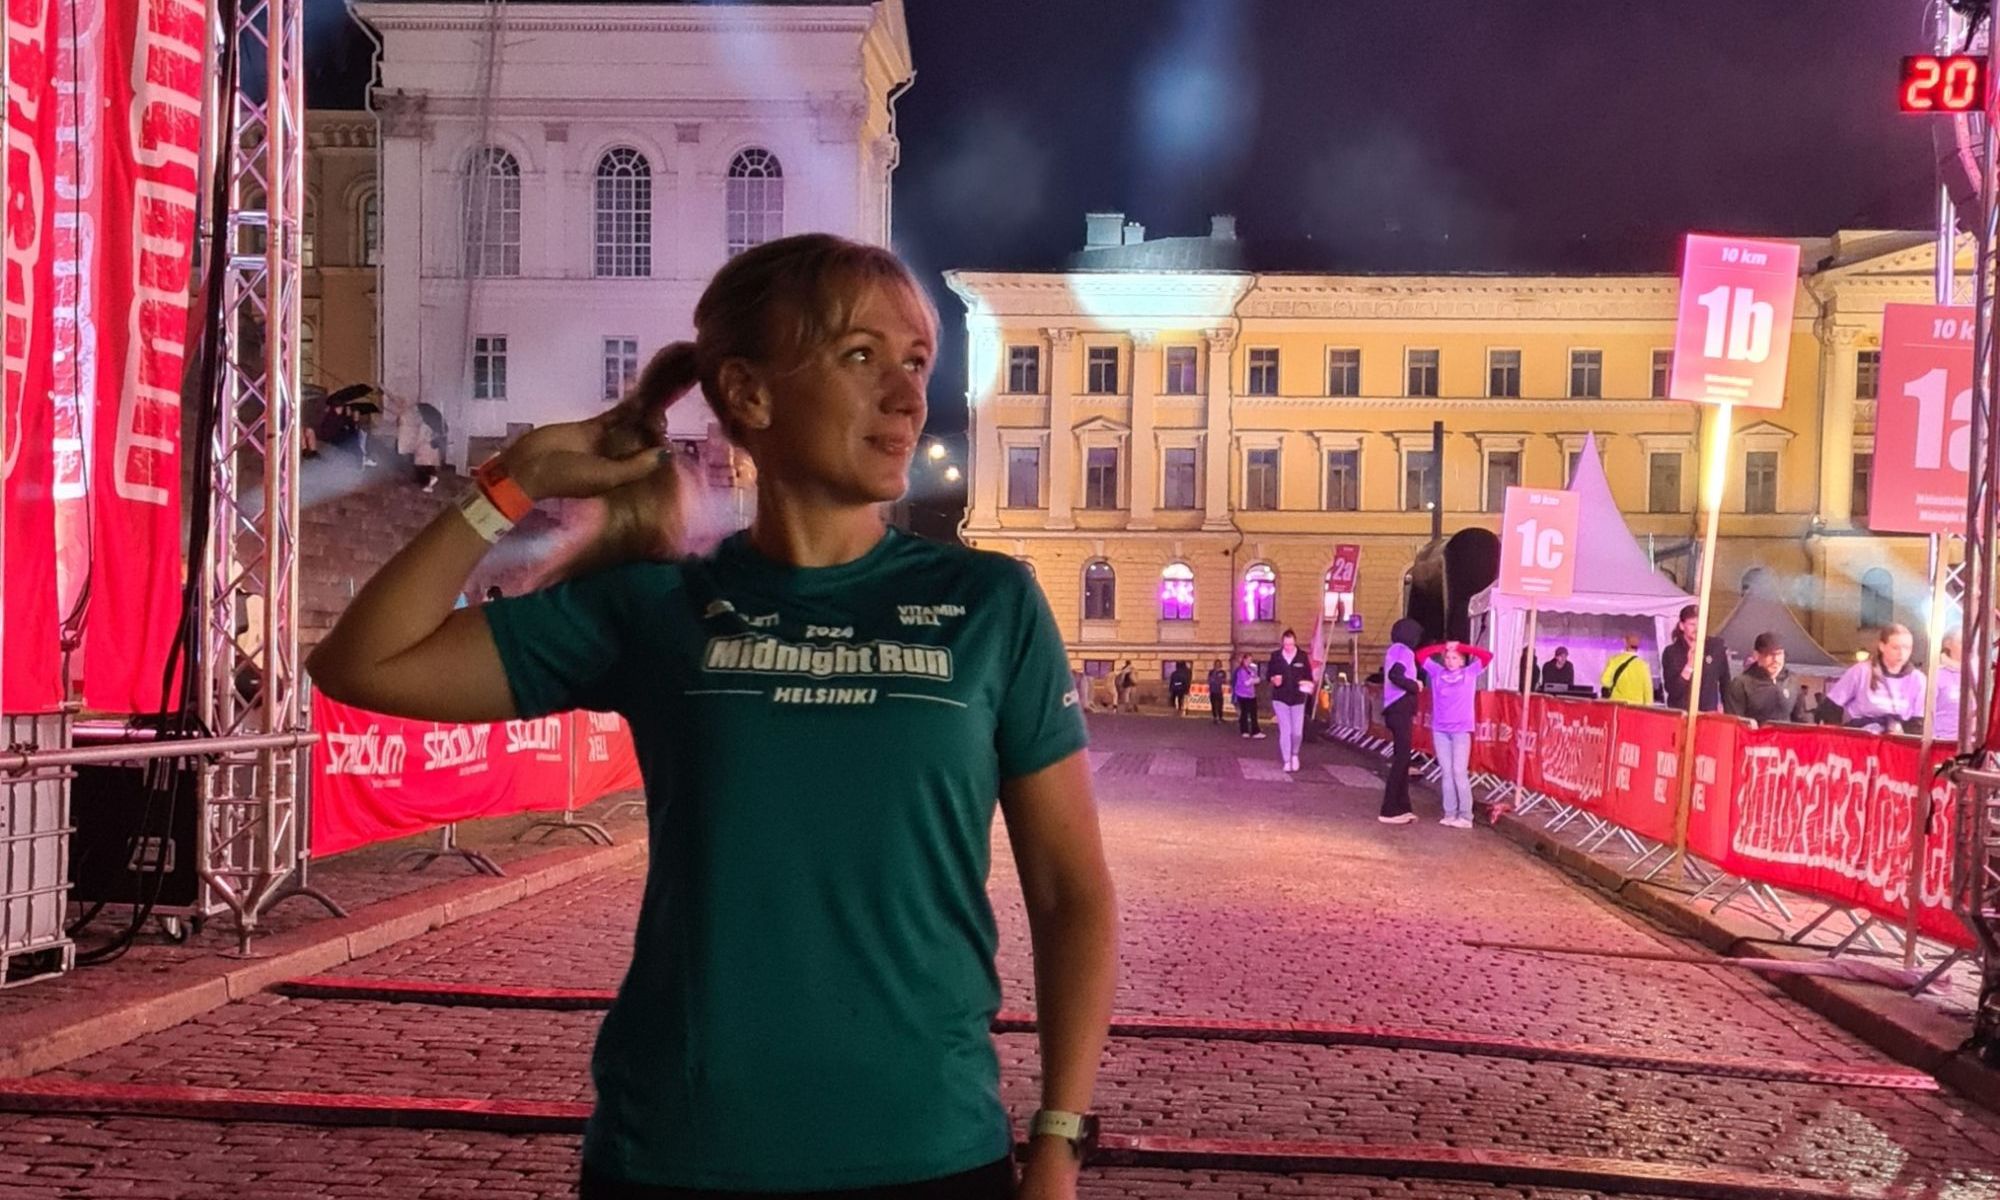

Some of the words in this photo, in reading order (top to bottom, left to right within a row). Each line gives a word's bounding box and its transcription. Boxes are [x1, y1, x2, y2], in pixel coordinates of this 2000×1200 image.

[1906, 58, 1977, 108] 20
[1721, 247, 1738, 262] 10
[1740, 248, 1768, 266] km
[1697, 285, 1774, 364] 1b
[1932, 318, 1957, 340] 10
[1516, 518, 1565, 570] 1c
[1332, 556, 1355, 582] 2a
[805, 624, 854, 639] 2024
[707, 637, 873, 677] Midnight
[877, 643, 950, 678] Run
[773, 686, 878, 706] HELSINKI
